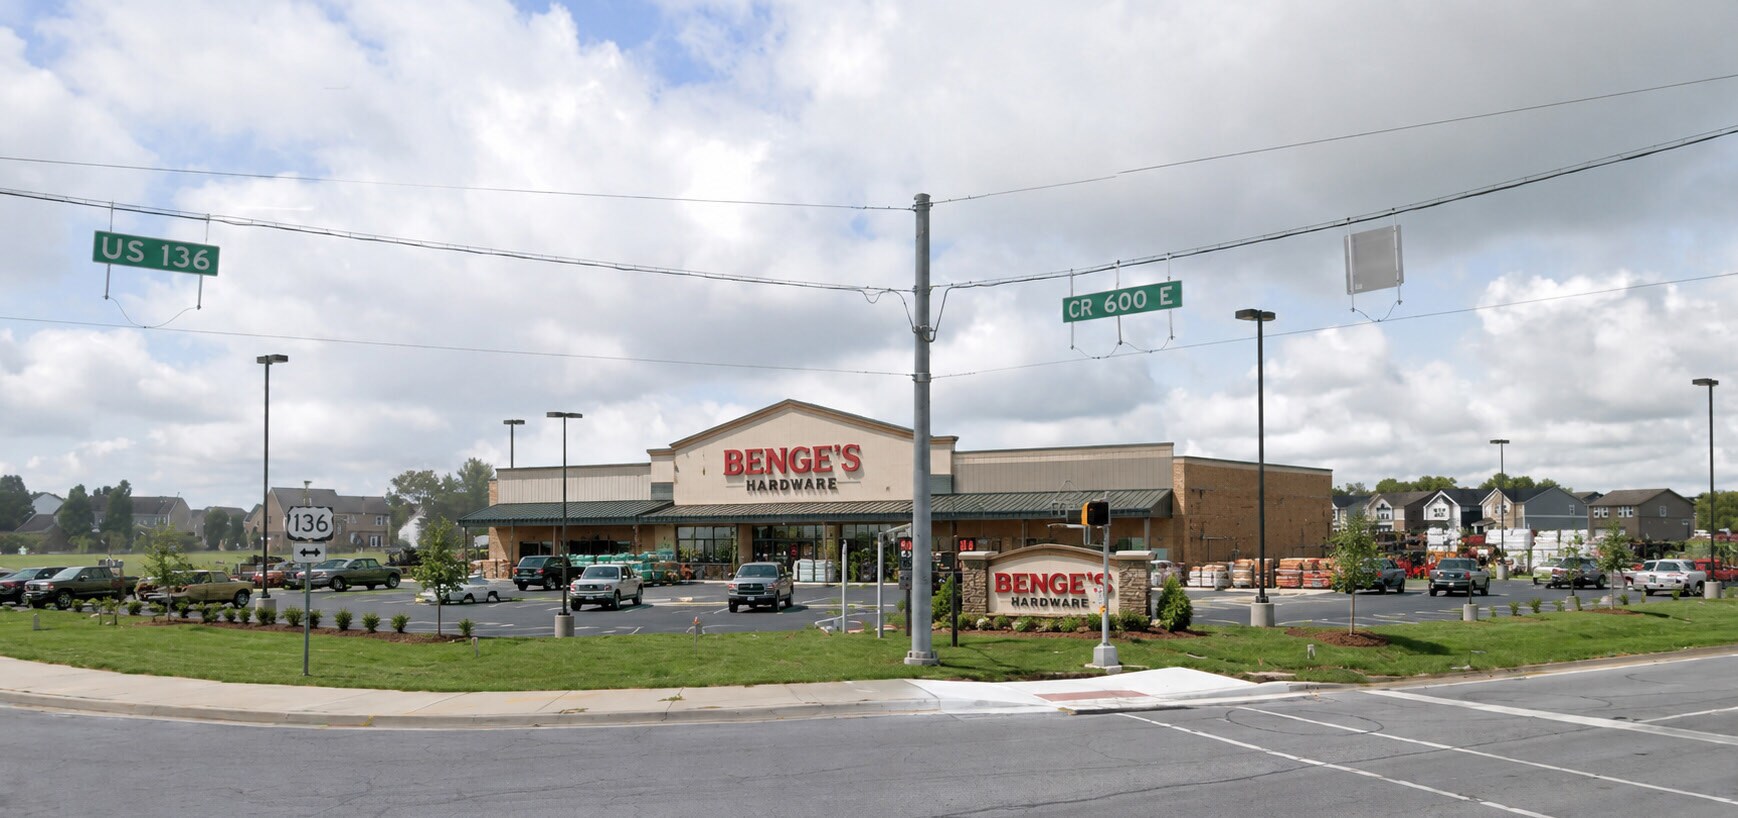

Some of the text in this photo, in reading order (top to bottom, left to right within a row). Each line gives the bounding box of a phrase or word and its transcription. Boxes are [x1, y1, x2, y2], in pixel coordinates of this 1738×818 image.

[102, 236, 210, 271] US 136
[1068, 285, 1173, 319] CR 600 E
[723, 443, 861, 476] BENGE'S
[746, 477, 838, 492] HARDWARE
[294, 513, 329, 532] 136
[994, 571, 1113, 595] BENGE'S
[1011, 596, 1089, 608] HARDWARE
